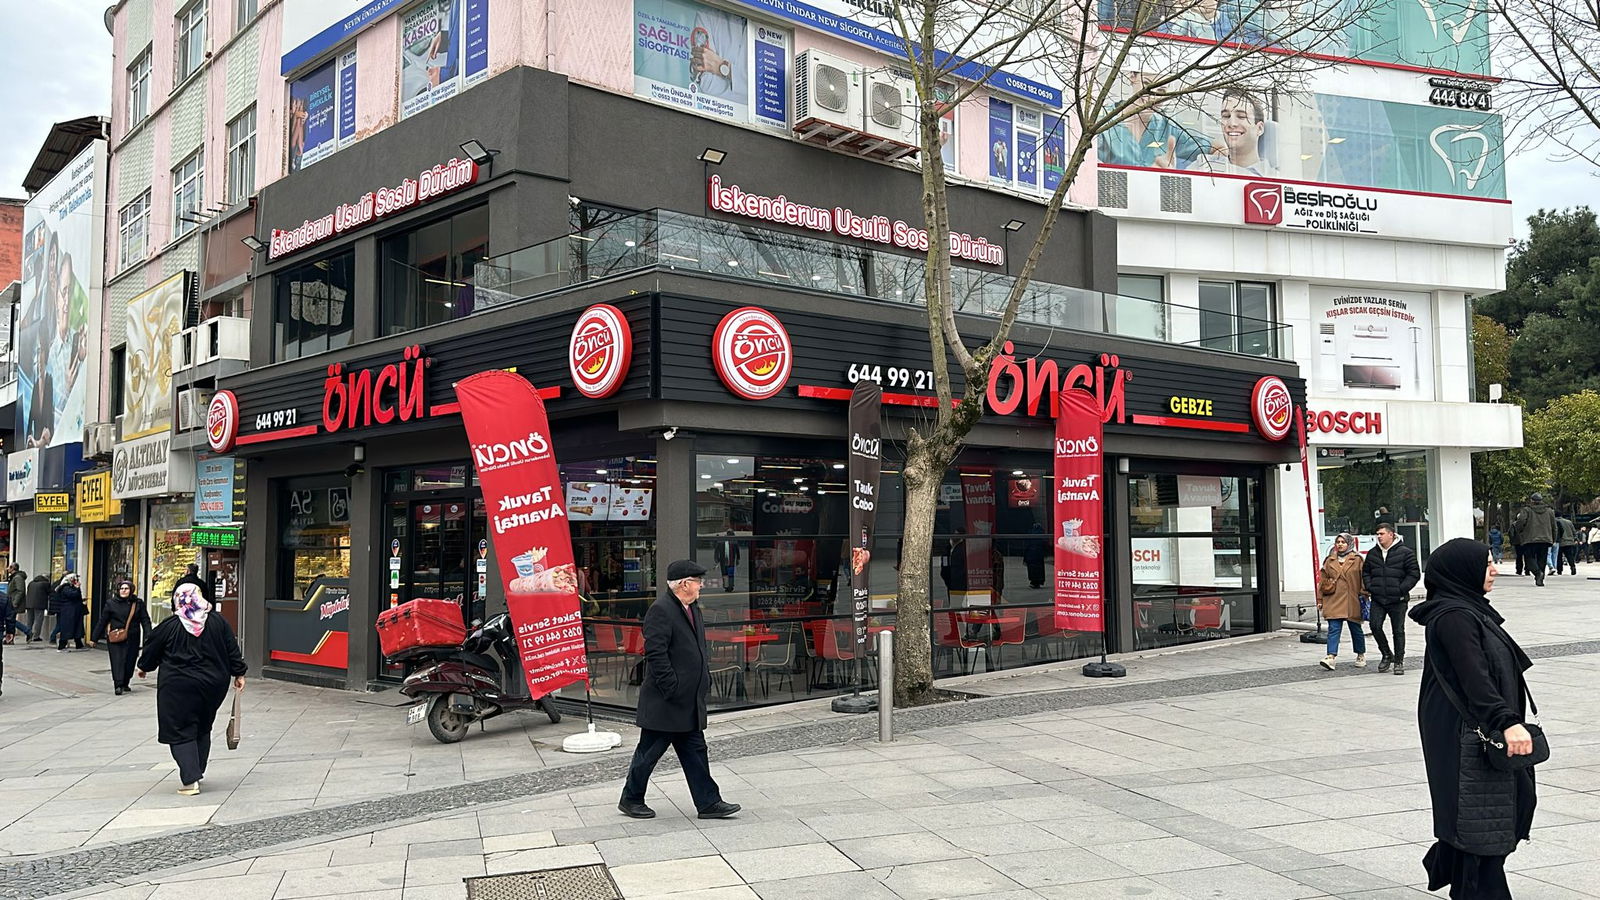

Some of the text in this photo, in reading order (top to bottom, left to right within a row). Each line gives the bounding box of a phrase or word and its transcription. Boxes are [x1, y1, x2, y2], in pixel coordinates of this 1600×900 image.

[403, 18, 438, 47] KASKO
[786, 3, 817, 22] ÜNDAR
[818, 15, 839, 29] NEW
[840, 22, 875, 41] SİGORTA
[638, 22, 690, 49] SAĞLIK
[766, 30, 783, 40] NEW
[638, 37, 690, 60] SİGORTASI
[651, 84, 734, 111] Nevin ÜNDAR NEW Sigorta
[1012, 80, 1054, 100] 0552 182 0639
[1433, 88, 1492, 108] 444 86 41
[270, 157, 473, 260] İskenderun Usulü Soslu Dürüm
[1284, 190, 1378, 211] BEŞİROĞLU
[711, 174, 1004, 266] İskenderun Usulü Sos Dürüm
[1294, 208, 1313, 217] AĞIZ
[1326, 210, 1338, 219] DİŞ
[1339, 211, 1370, 222] SAĞLIĞI
[1305, 219, 1359, 232] POLİKLİNİĞİ
[1333, 294, 1407, 310] EVİNİZDE YAZLAR SERİN
[1326, 306, 1415, 323] KIŞLAR SICAK GEÇSİN İSTEDİK
[847, 363, 934, 390] 644 99 21
[1170, 396, 1213, 416] GEBZE
[255, 408, 297, 430] 644 99 21
[1307, 410, 1382, 435] BOSCH
[129, 438, 169, 471] ALTINAY
[37, 496, 67, 505] EYFEL
[82, 478, 104, 503] EYFEL
[1132, 549, 1161, 562] SCH
